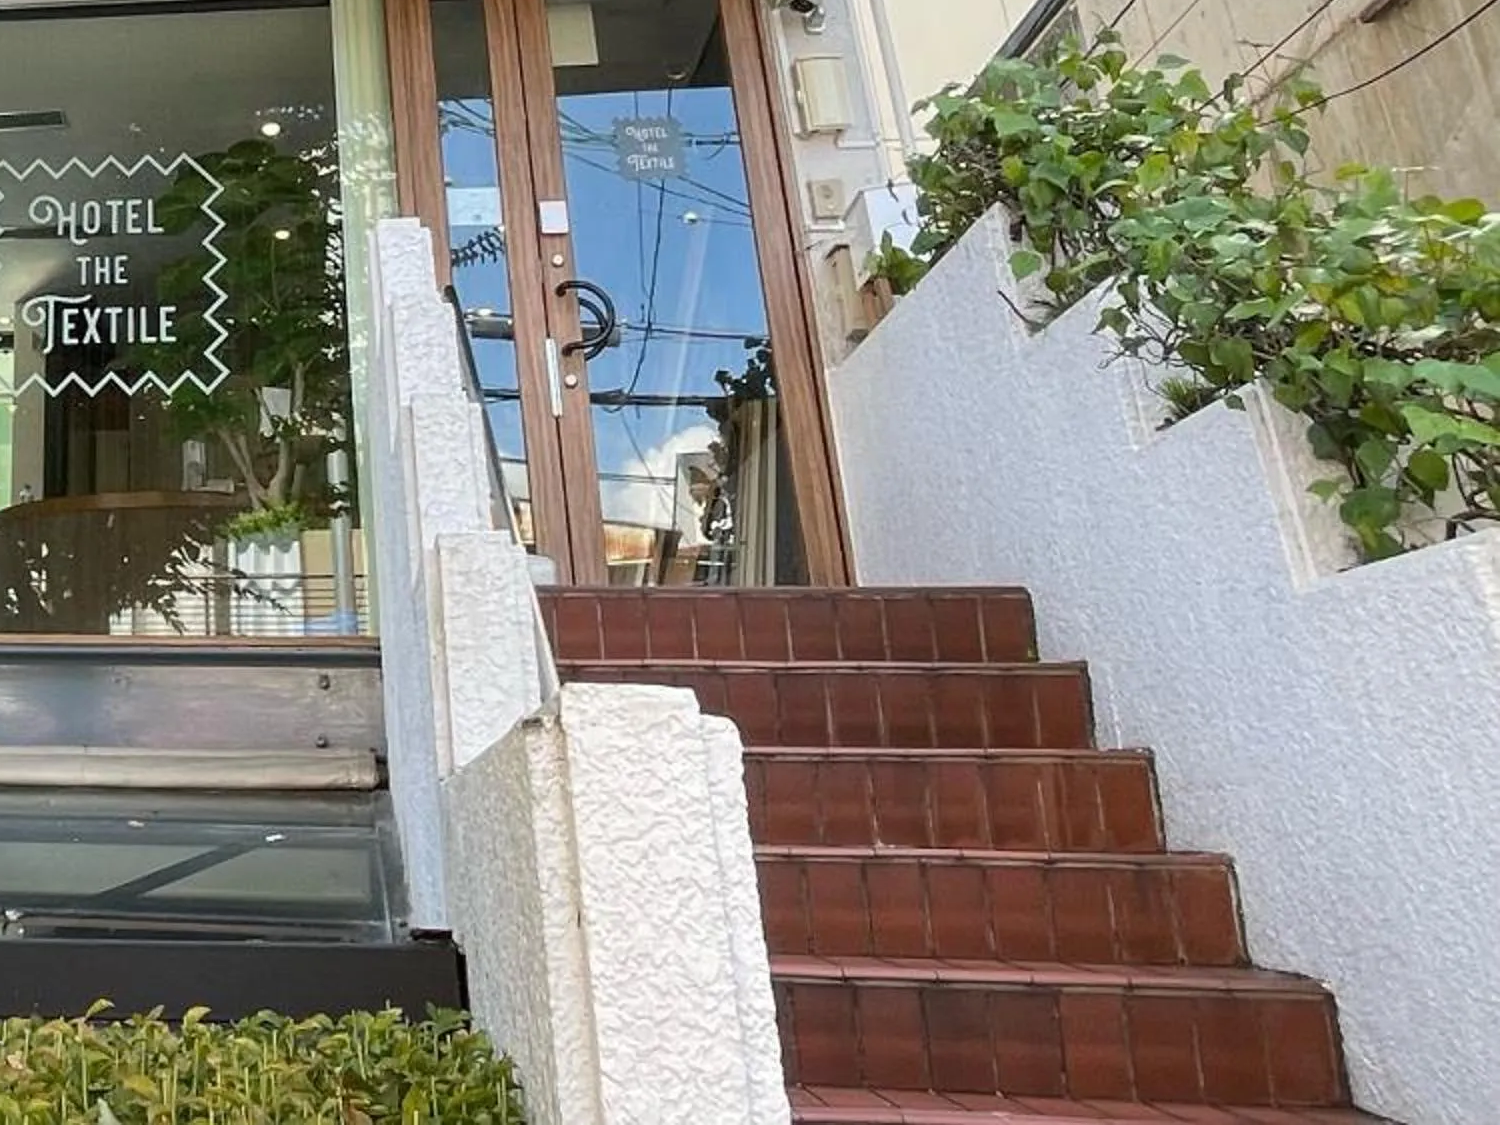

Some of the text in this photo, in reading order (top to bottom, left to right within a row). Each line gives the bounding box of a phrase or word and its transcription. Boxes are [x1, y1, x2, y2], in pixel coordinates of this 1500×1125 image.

[28, 194, 166, 246] HOTEL
[75, 255, 129, 287] THE
[21, 293, 178, 355] TEXTILE
